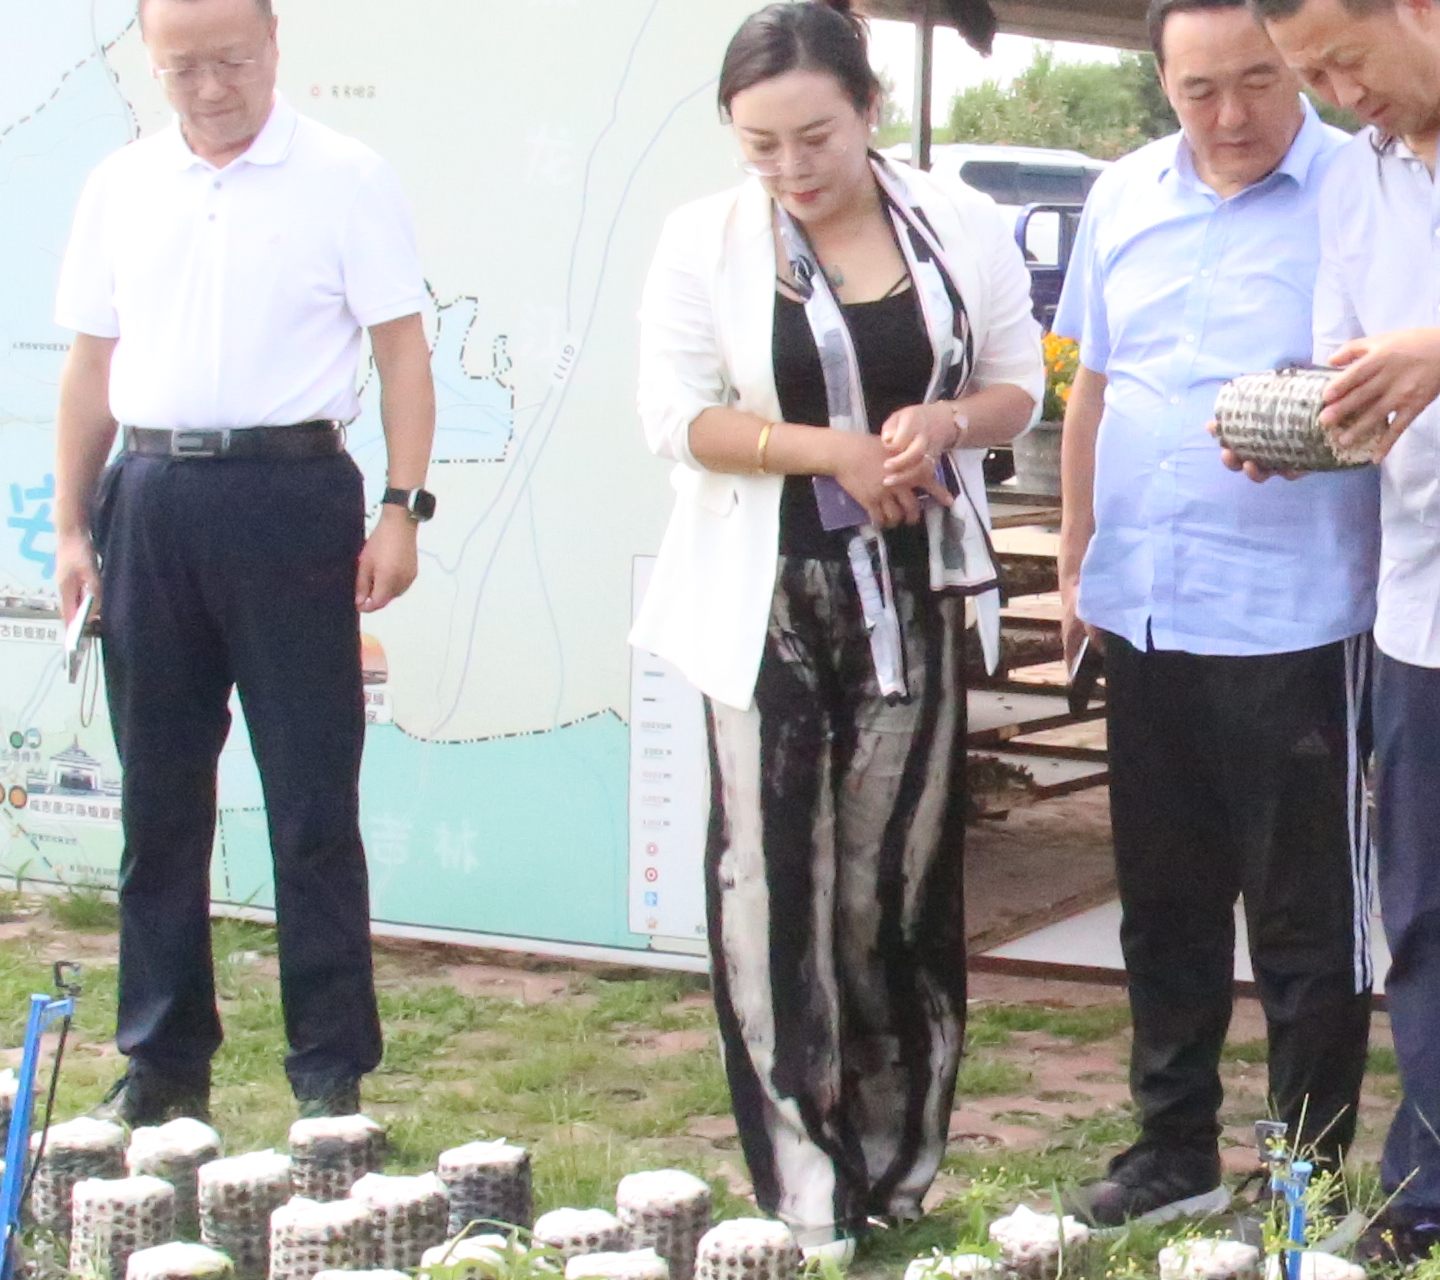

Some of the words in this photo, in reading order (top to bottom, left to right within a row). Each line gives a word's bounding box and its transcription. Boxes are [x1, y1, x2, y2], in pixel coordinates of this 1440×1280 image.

[330, 83, 376, 99] 齐齐哈尔
[553, 343, 575, 380] G111
[369, 810, 480, 874] 吉林
